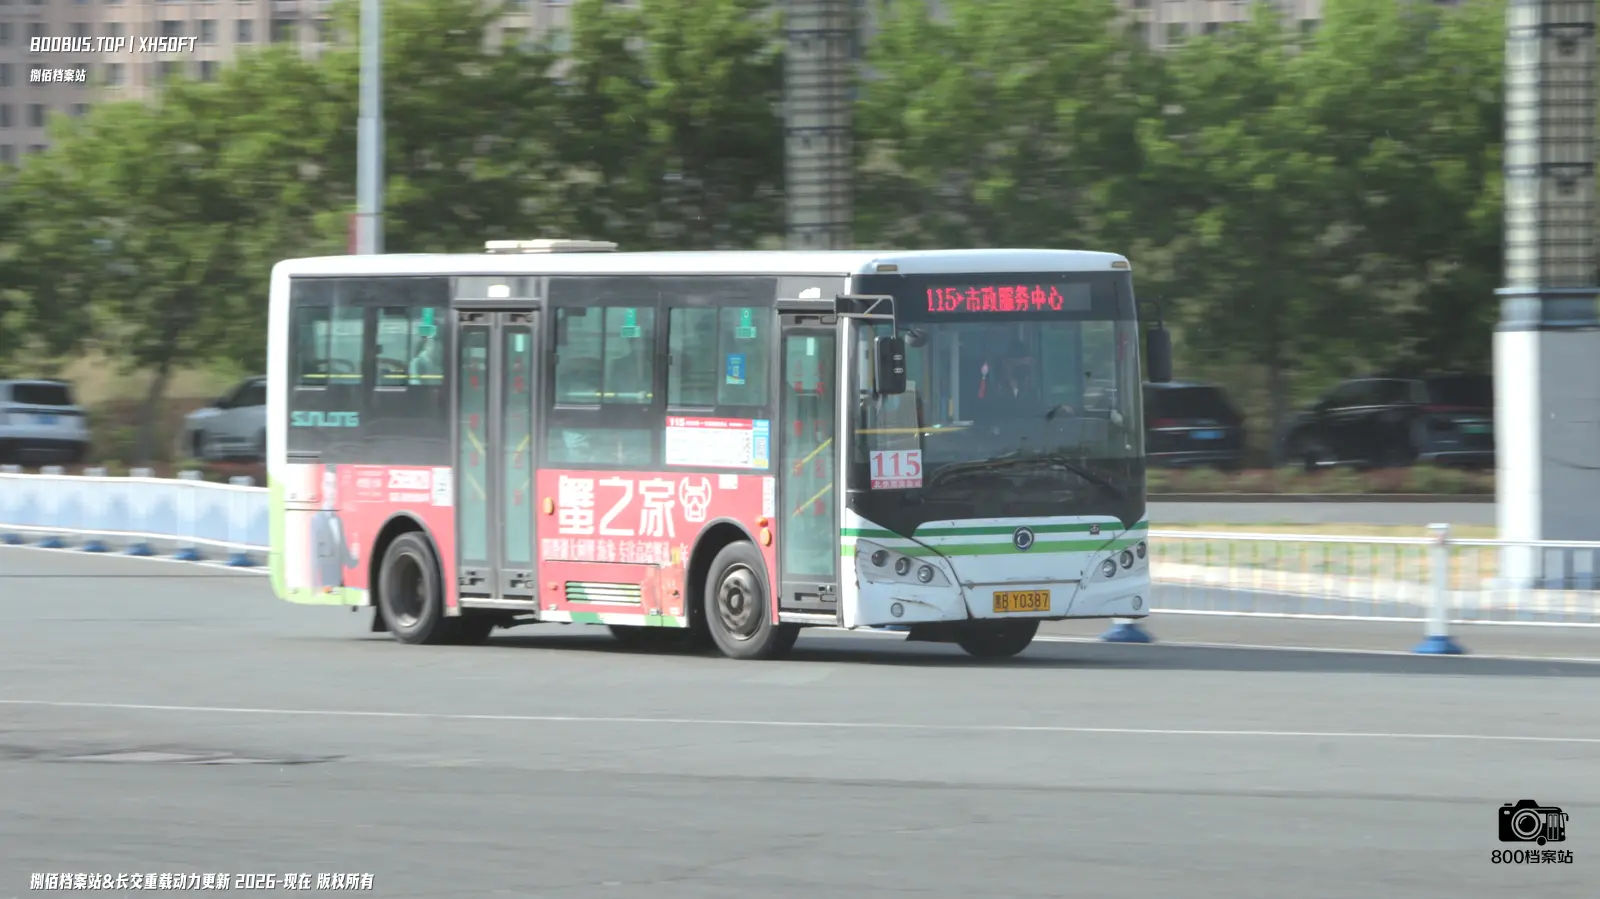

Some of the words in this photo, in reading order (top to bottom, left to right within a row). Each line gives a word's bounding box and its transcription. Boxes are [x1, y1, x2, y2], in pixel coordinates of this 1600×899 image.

[926, 288, 957, 312] 115
[964, 285, 1064, 312] 市政服务中心
[872, 452, 921, 478] 115
[558, 475, 676, 538] 蟹之家
